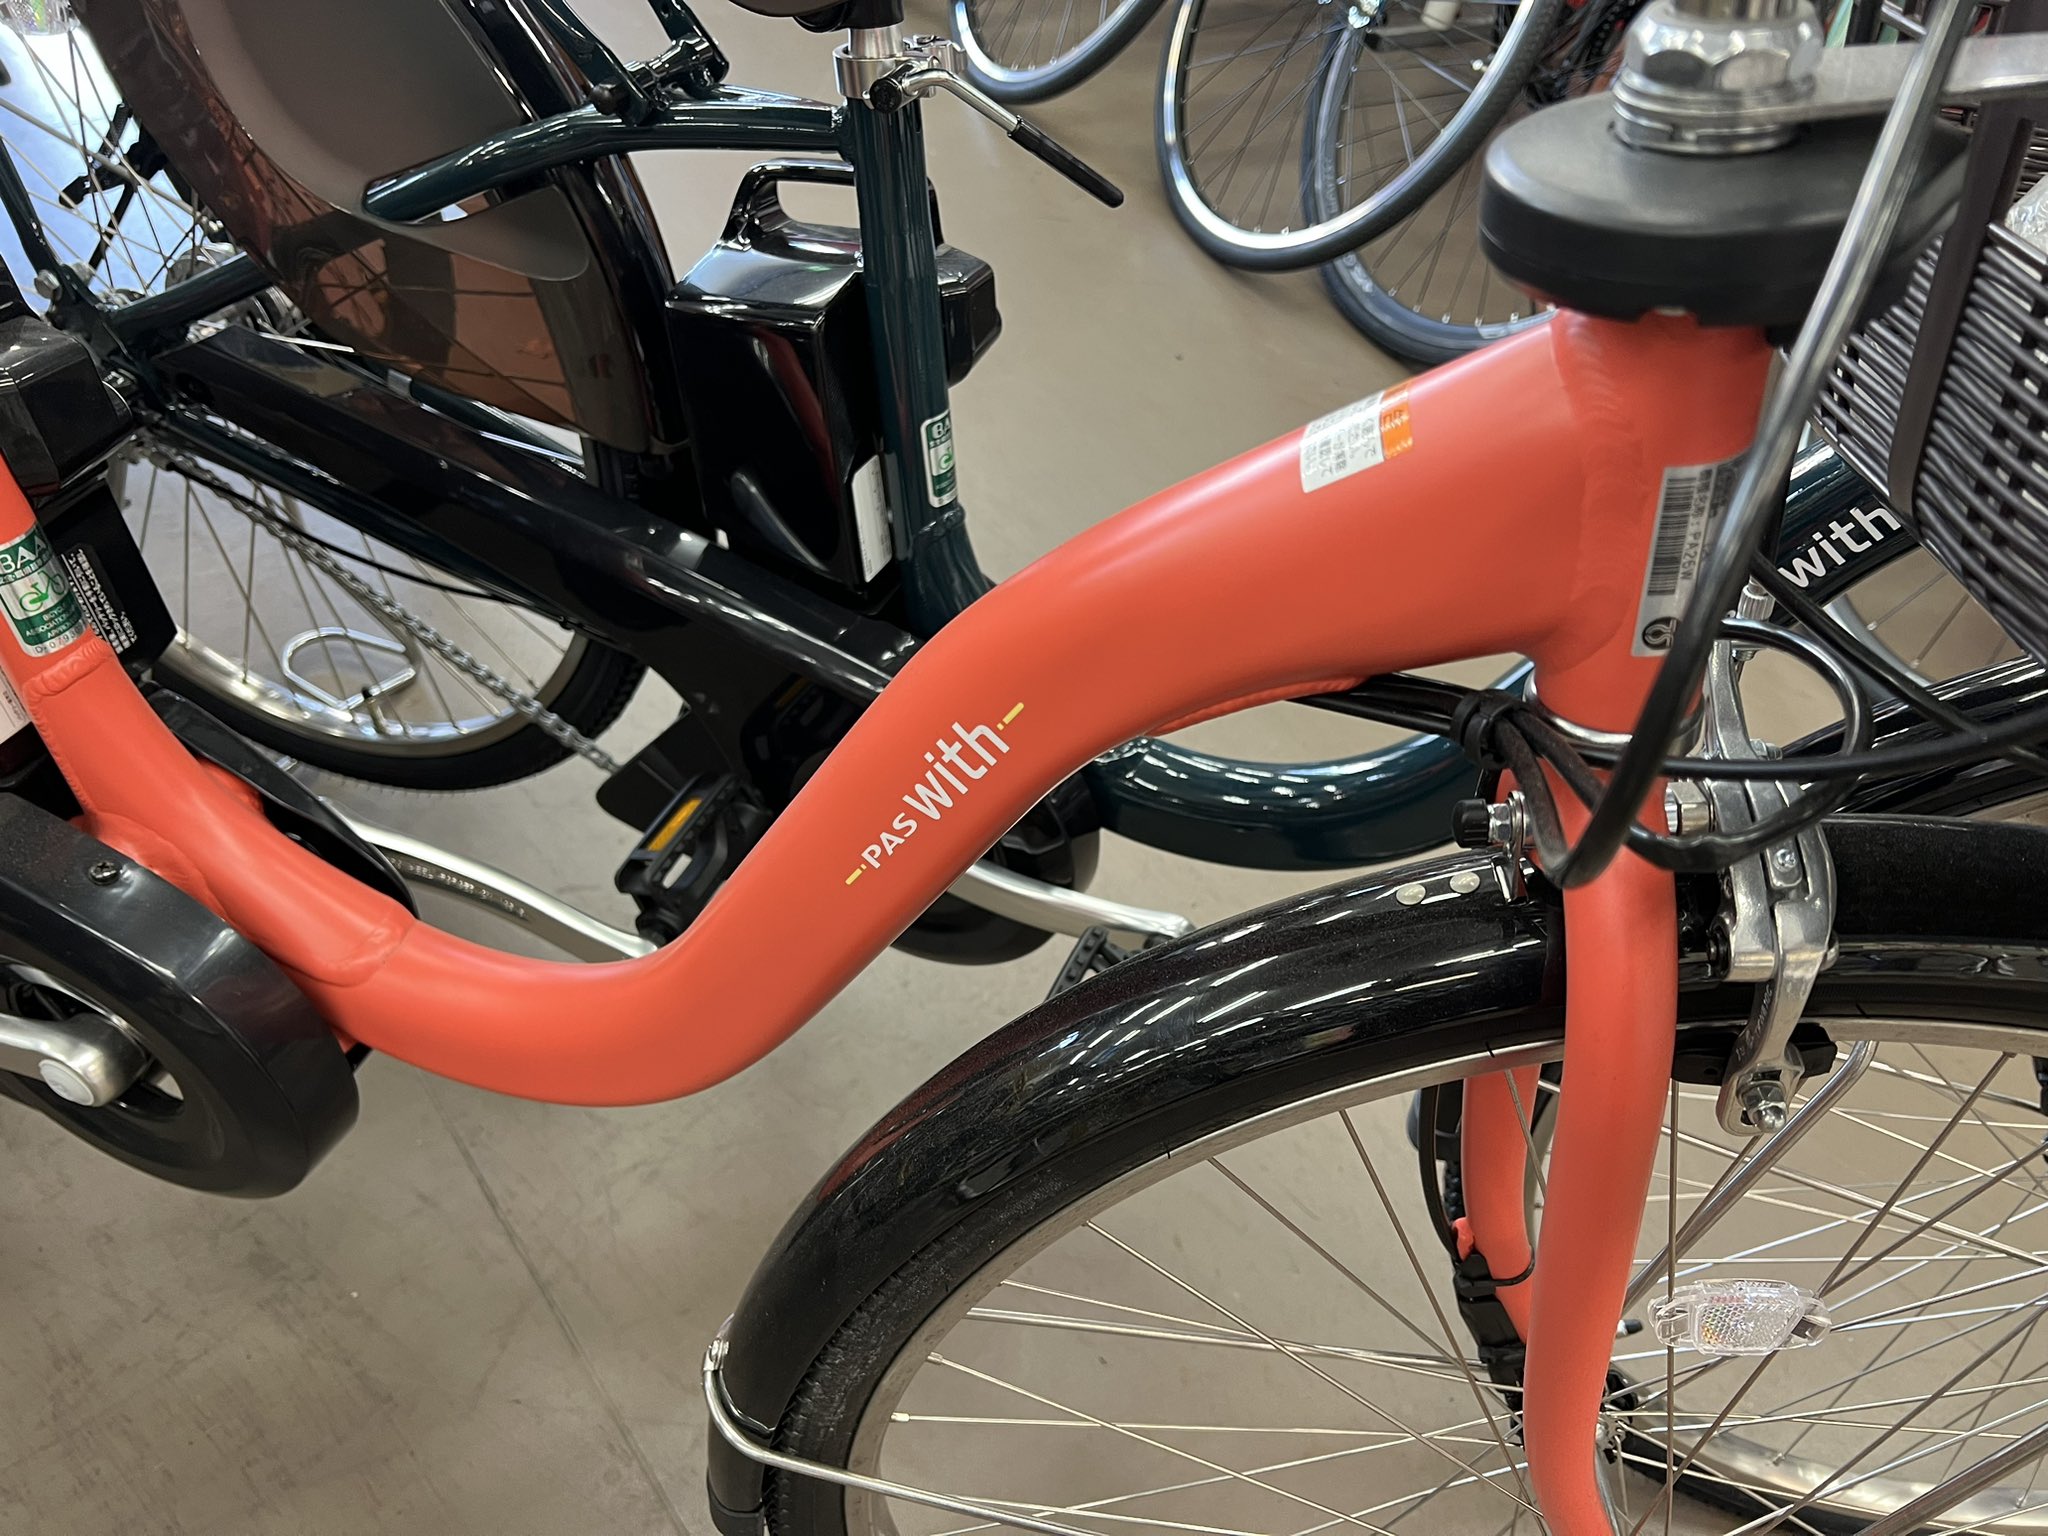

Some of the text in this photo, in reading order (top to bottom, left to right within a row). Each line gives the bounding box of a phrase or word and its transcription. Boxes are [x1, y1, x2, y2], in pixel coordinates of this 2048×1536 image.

[1777, 507, 1901, 588] with
[861, 721, 1010, 869] PAS with
